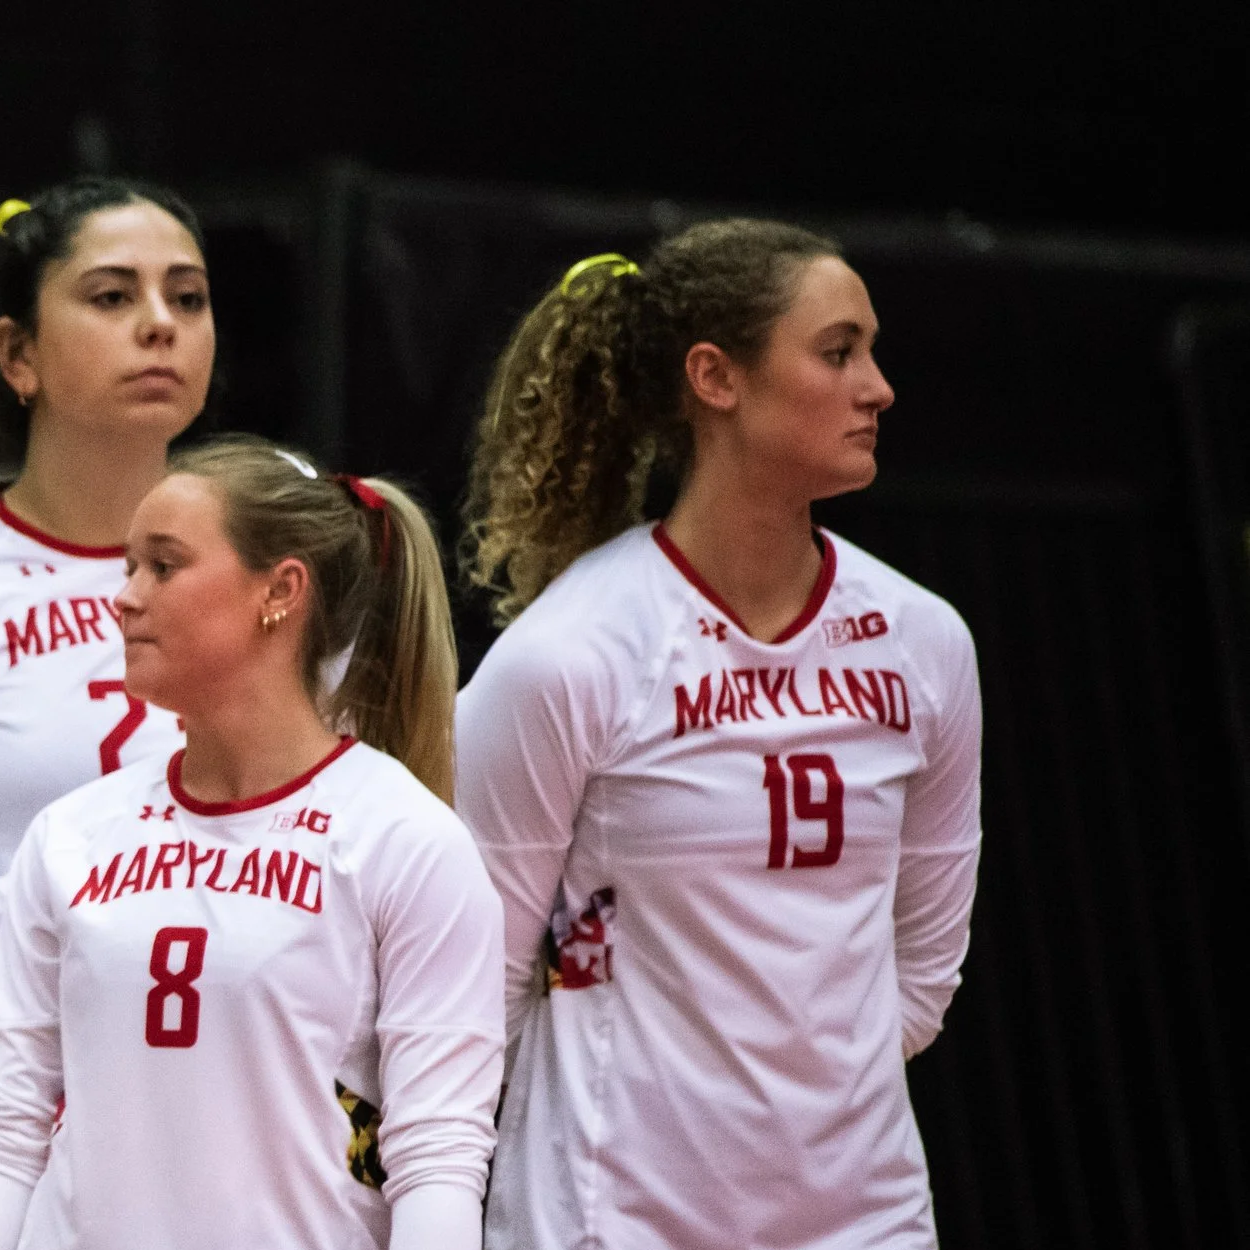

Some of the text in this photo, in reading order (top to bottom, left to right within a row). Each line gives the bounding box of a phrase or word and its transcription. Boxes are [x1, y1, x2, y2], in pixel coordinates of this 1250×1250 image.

[673, 667, 911, 739] MARYLAND
[763, 754, 845, 870] 19
[68, 840, 323, 915] MARYLAND
[145, 926, 209, 1049] 8
